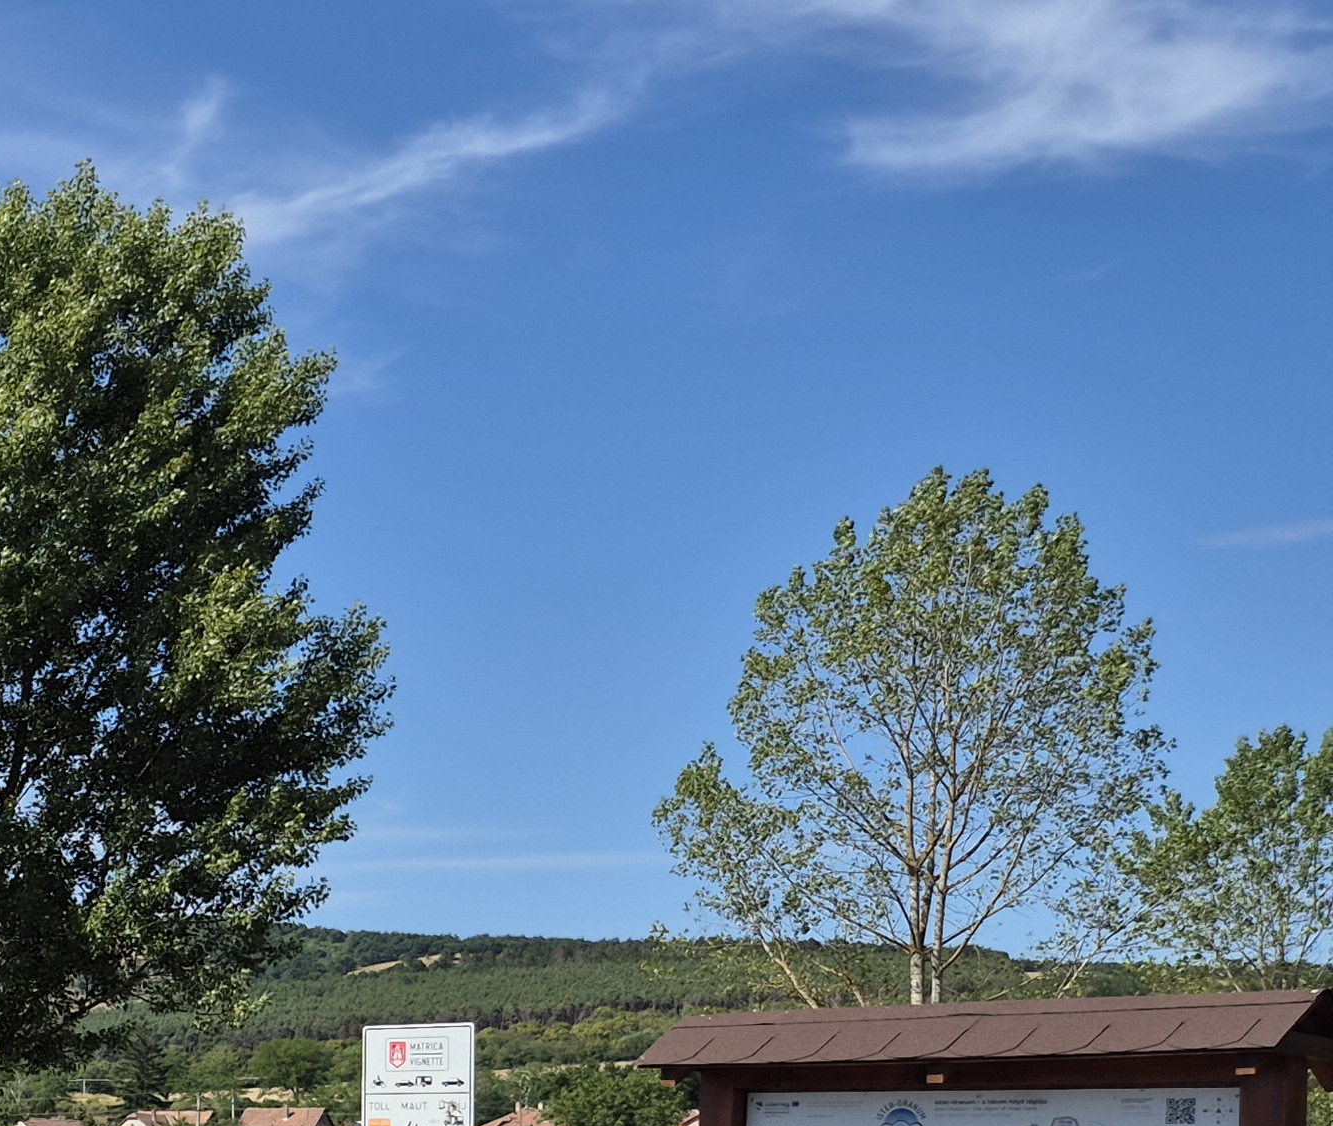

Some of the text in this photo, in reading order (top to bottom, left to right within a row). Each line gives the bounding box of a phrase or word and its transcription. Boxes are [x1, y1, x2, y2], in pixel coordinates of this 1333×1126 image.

[409, 1042, 443, 1051] MATRICA
[409, 1057, 443, 1066] VIGNETTE
[369, 1101, 390, 1110] TOLL
[401, 1101, 428, 1110] MAUT
